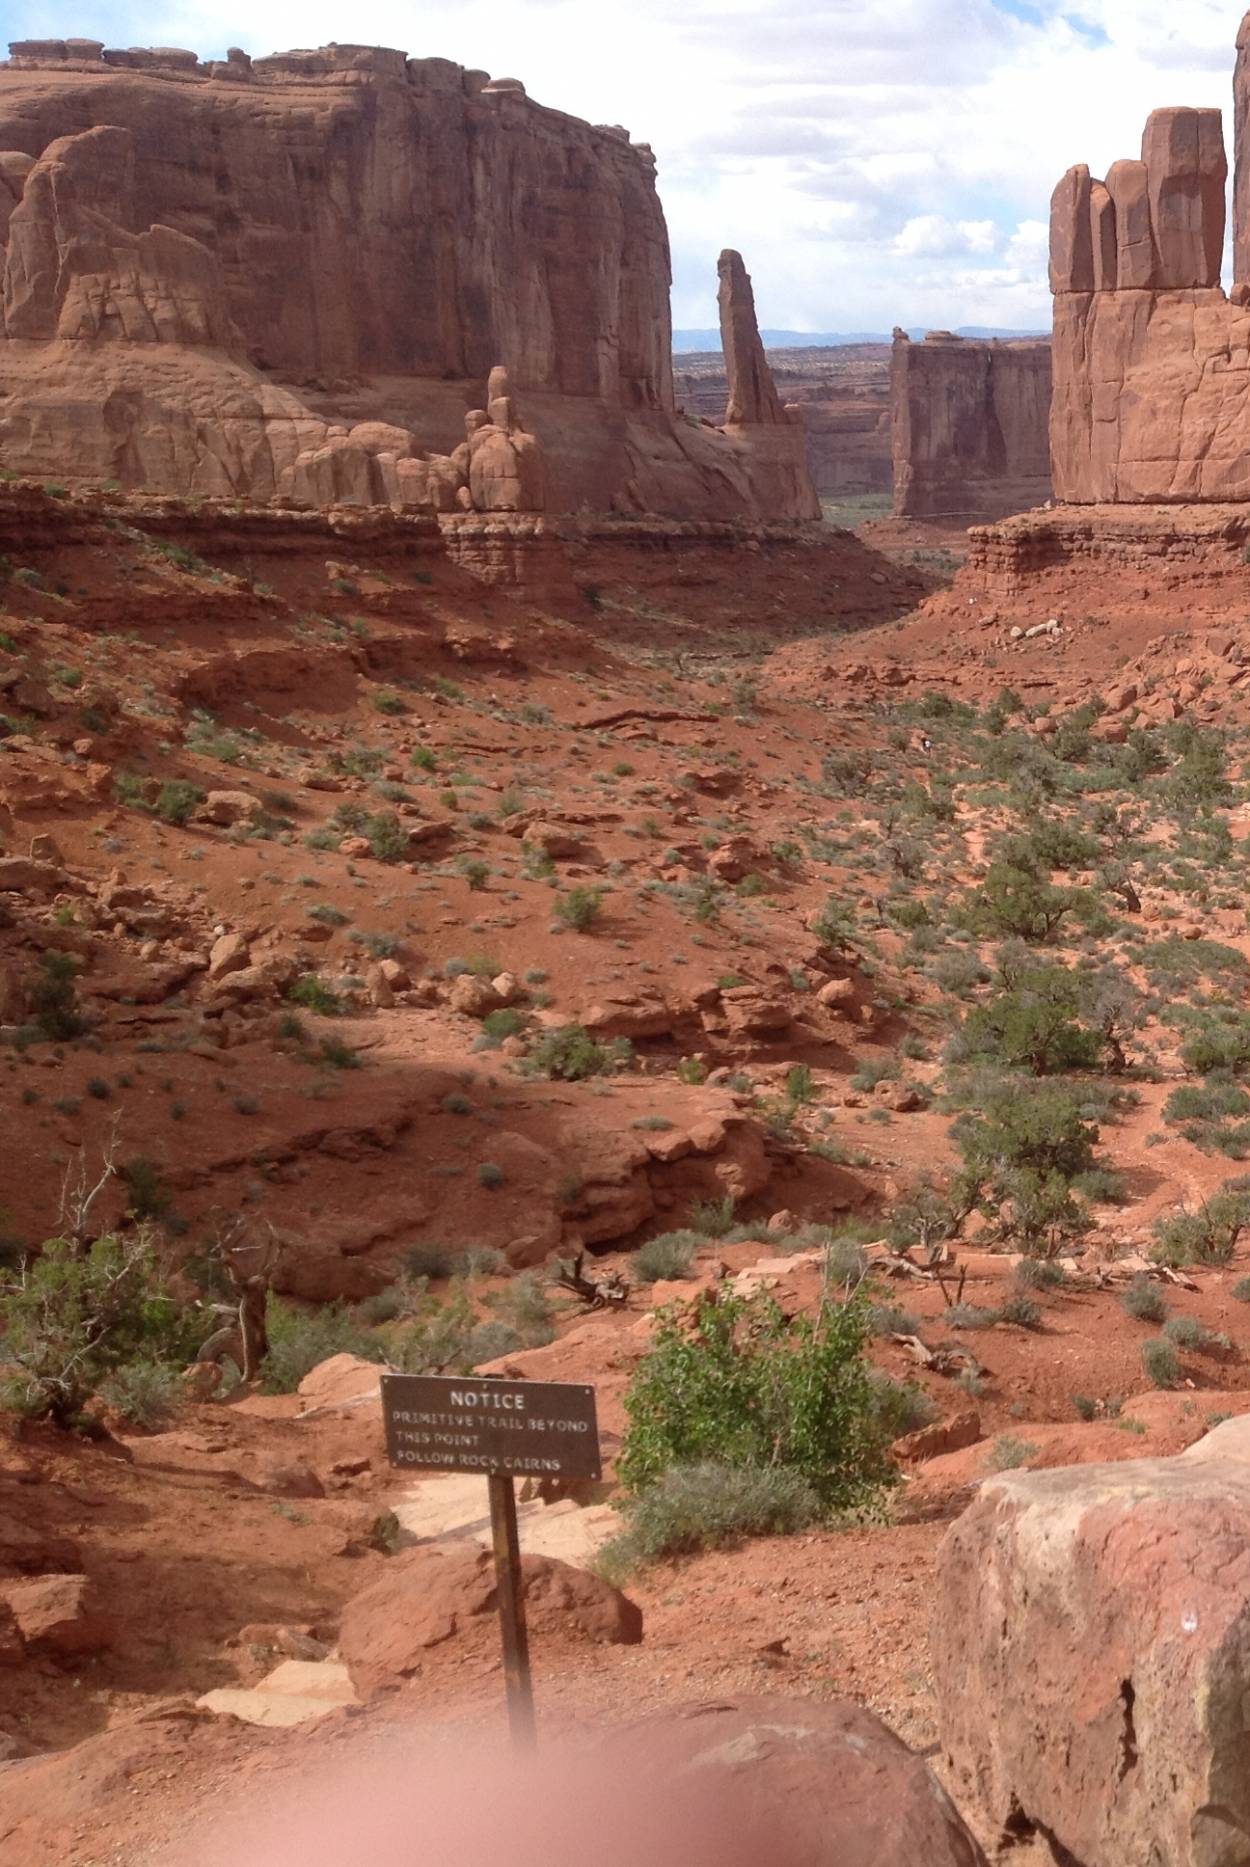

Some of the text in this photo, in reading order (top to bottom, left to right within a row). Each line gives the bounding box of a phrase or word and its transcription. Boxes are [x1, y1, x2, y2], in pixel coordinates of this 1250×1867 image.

[450, 1391, 525, 1410] NOTICE
[392, 1411, 588, 1433] PRIMITIVE TRAIL BEYOND
[396, 1431, 480, 1446] THIS POINT
[396, 1451, 561, 1471] FOLLOW ROCK CAIRNS
